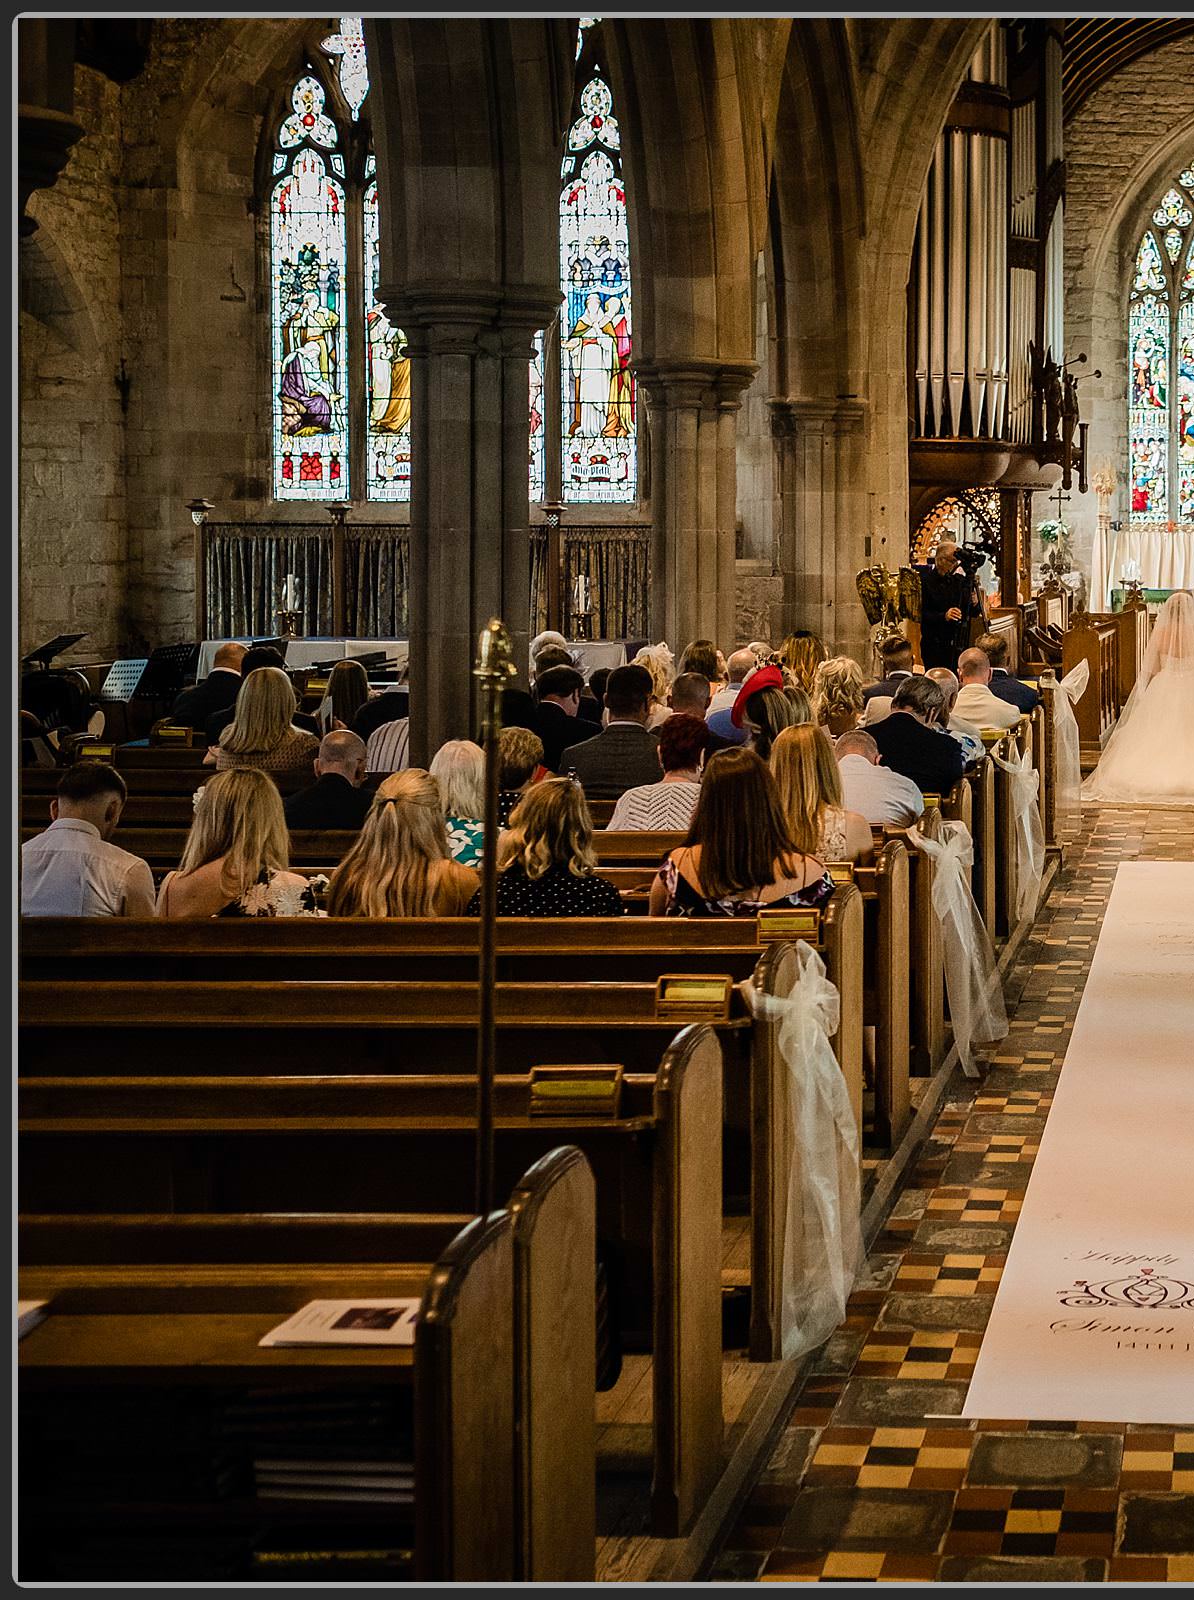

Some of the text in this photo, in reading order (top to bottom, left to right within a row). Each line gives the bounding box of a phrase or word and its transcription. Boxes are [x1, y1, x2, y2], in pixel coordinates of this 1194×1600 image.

[1063, 1250, 1180, 1266] Happily
[1049, 1318, 1175, 1335] Simon
[1115, 1341, 1175, 1351] 14TH
